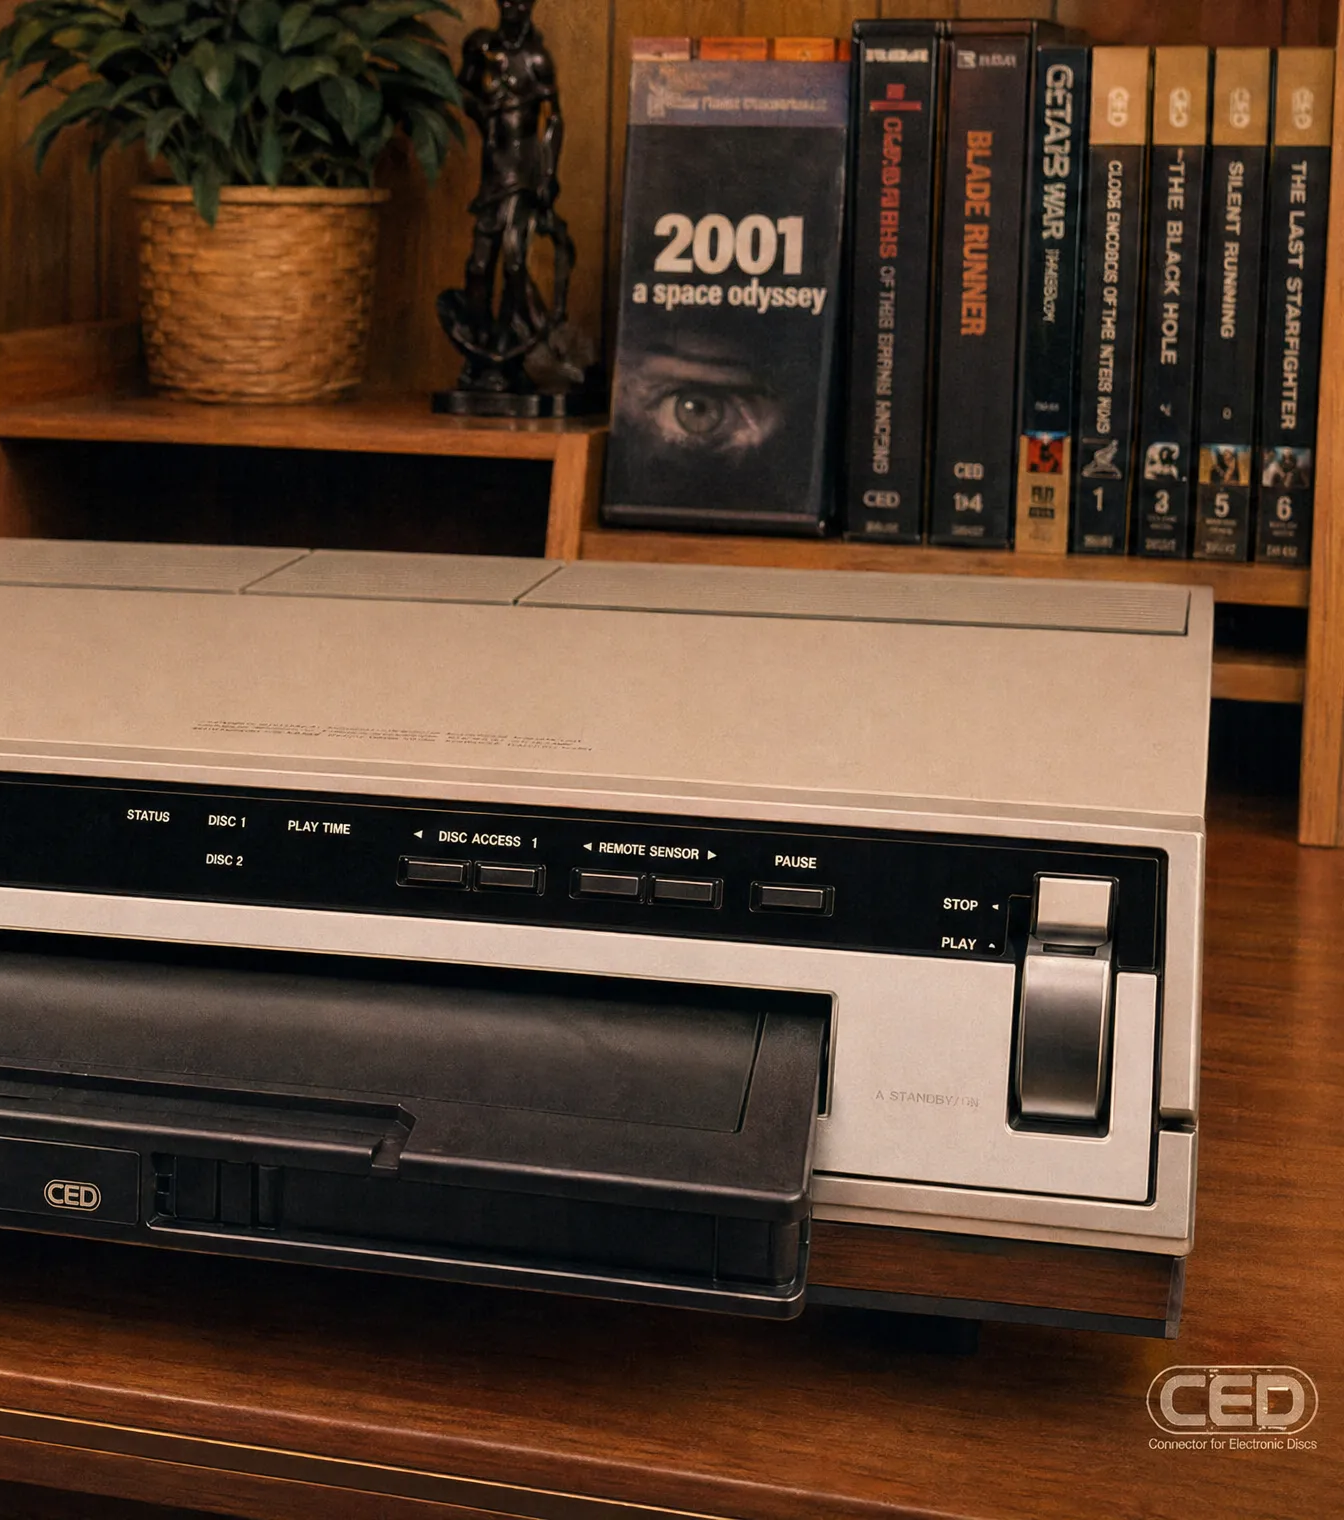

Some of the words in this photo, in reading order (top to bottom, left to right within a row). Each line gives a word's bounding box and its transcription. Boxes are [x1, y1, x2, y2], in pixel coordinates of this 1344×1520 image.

[964, 130, 993, 217] BLADE
[1290, 161, 1307, 204] THE
[1167, 162, 1185, 211] THE
[1224, 161, 1244, 236] SILENT
[654, 214, 803, 274] 2001
[1287, 211, 1305, 269] LAST
[1164, 220, 1183, 296] BLACK
[960, 224, 990, 337] RUNNER
[1220, 241, 1240, 339] RUNNING
[633, 283, 647, 303] a
[653, 284, 722, 310] space
[728, 278, 826, 314] odyssey
[1160, 303, 1180, 365] HOLE
[1280, 277, 1303, 431] STARFIGHTER
[1093, 487, 1104, 511] 1
[1155, 490, 1169, 514] 3
[1214, 493, 1230, 518] 5
[1276, 496, 1292, 520] 6
[127, 809, 169, 822] STATUS
[209, 815, 236, 826] DISC
[242, 817, 245, 827] 1
[288, 820, 318, 832] PLAY
[323, 823, 350, 834] TIME
[439, 831, 467, 843] DISC
[472, 833, 520, 847] ACCESS
[599, 842, 645, 855] REMOTE
[650, 846, 699, 859] SENSOR
[206, 854, 232, 865] DISC
[236, 856, 243, 866] 2
[775, 855, 816, 868] PAUSE
[944, 898, 978, 910] STOP
[942, 937, 976, 950] PLAY
[46, 1183, 98, 1208] CED
